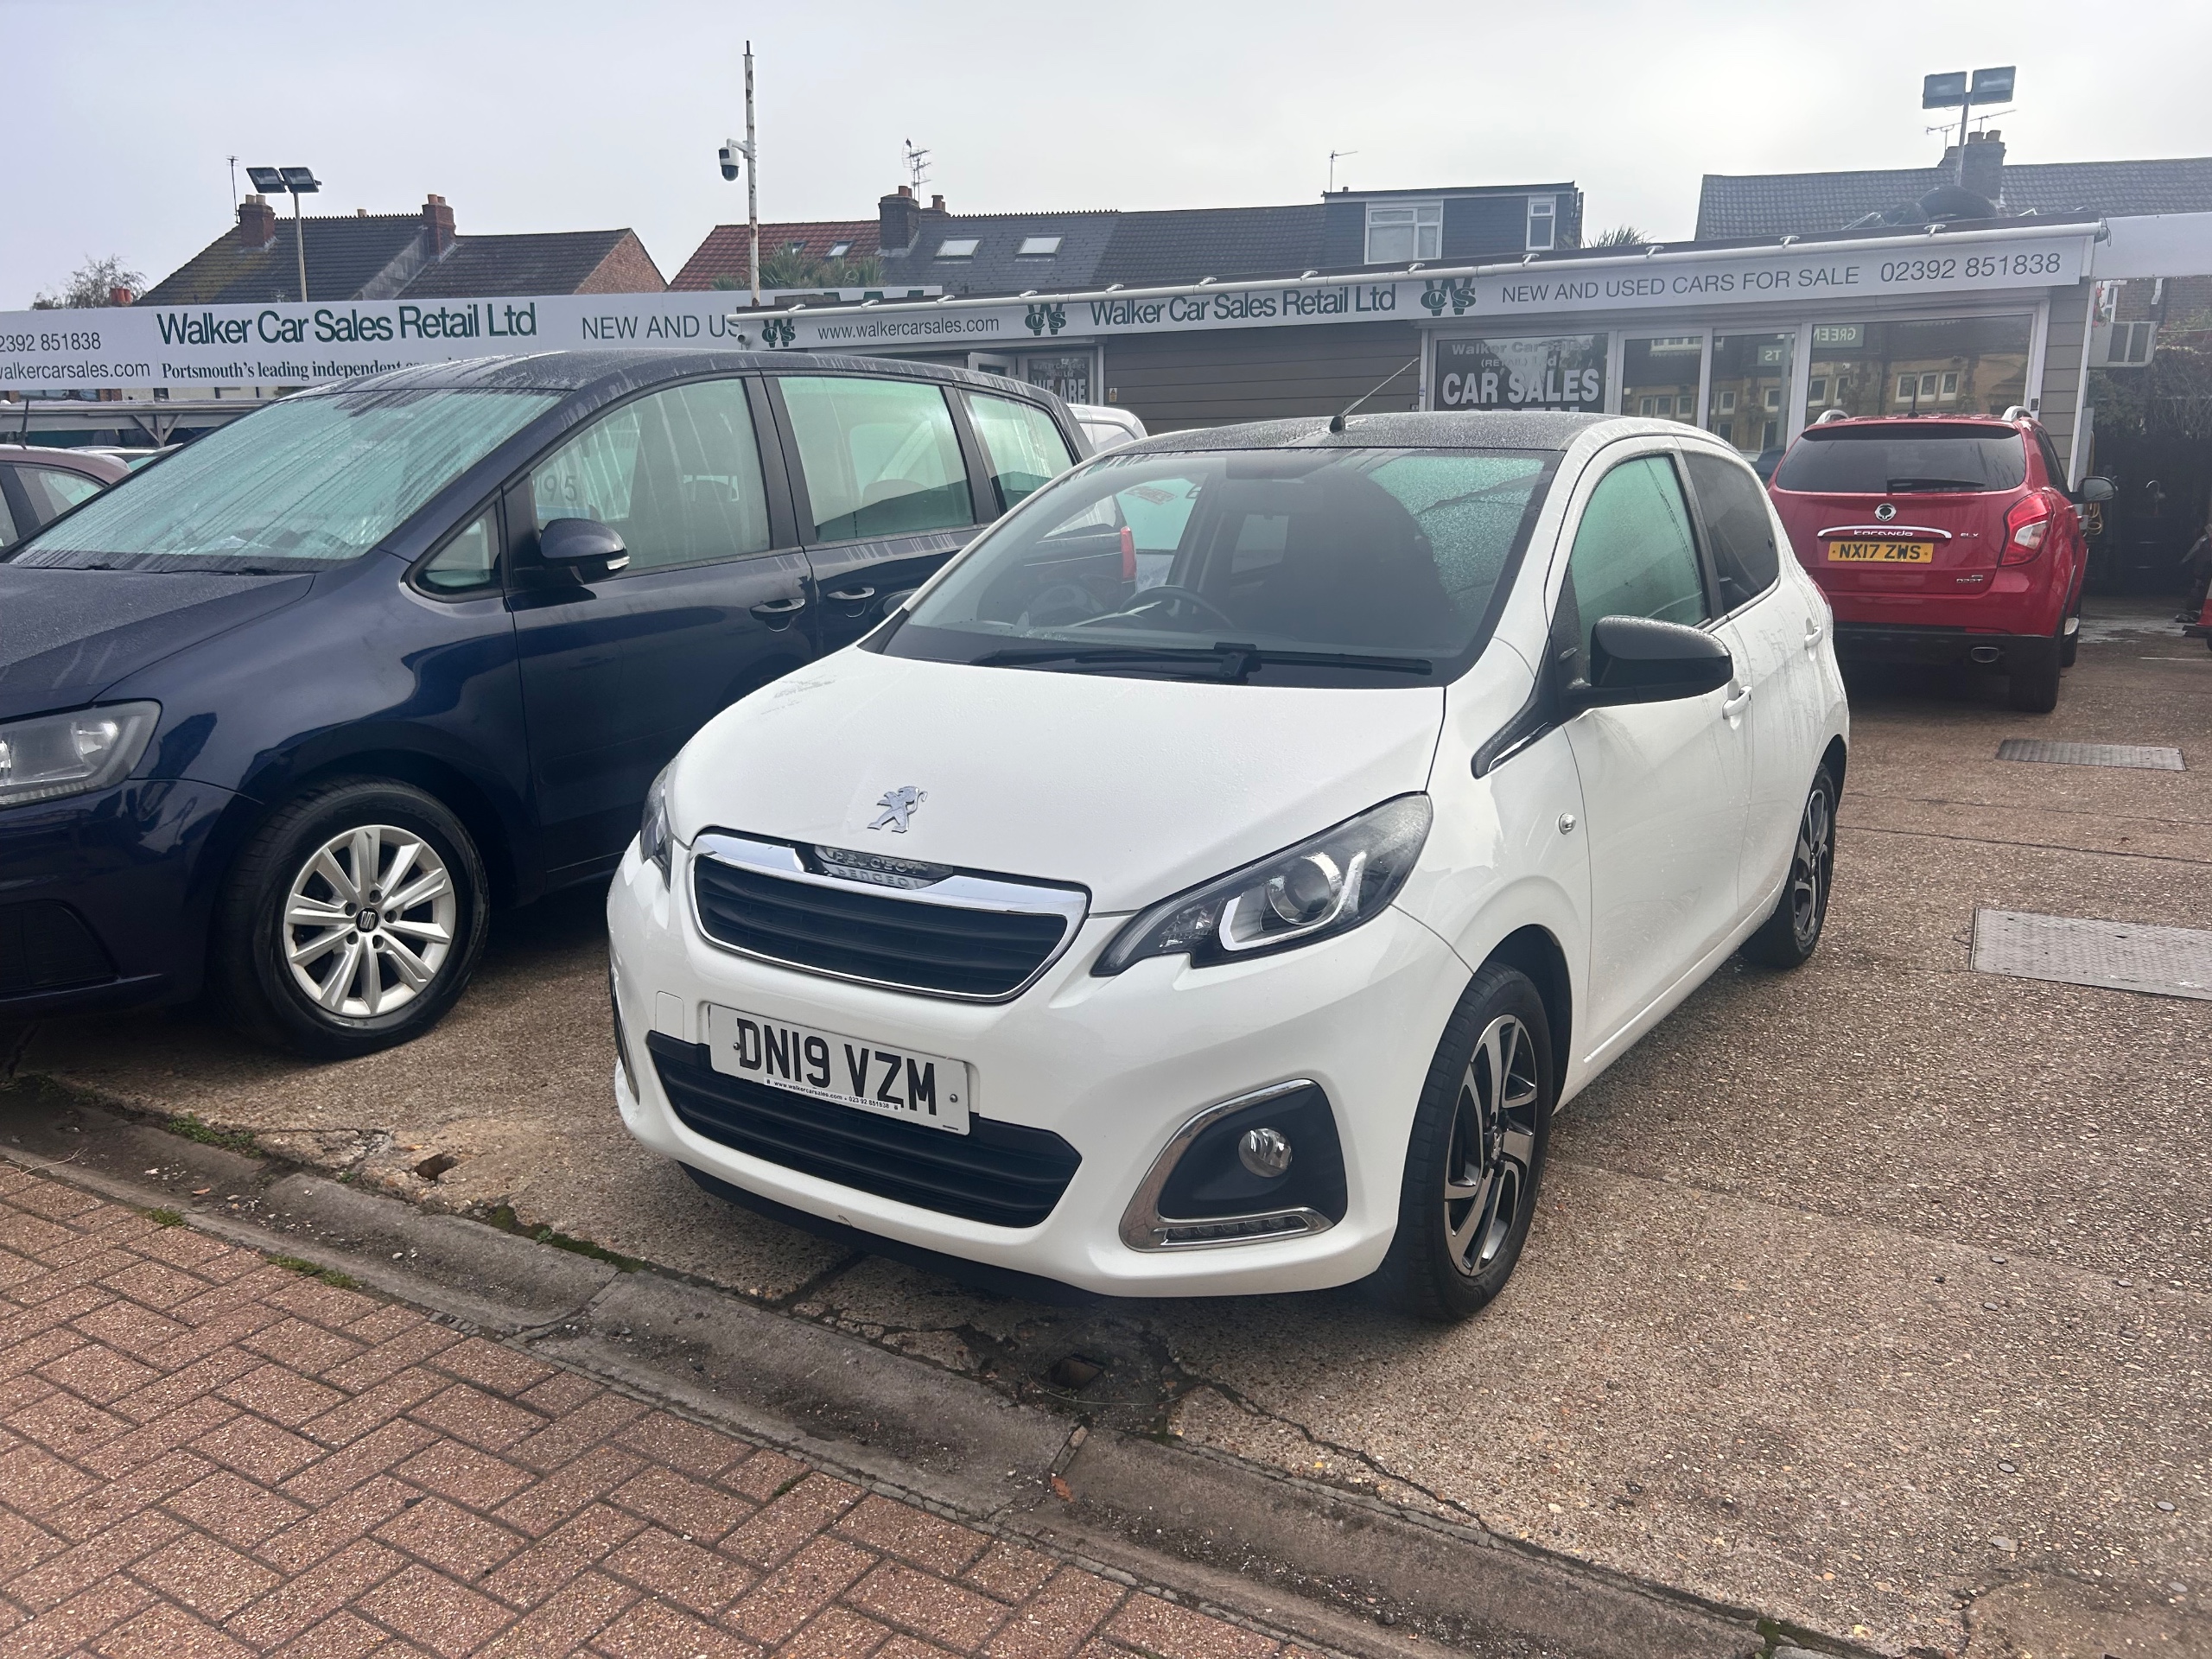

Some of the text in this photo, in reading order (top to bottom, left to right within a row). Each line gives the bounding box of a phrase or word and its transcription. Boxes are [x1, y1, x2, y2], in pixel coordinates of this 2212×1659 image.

[1502, 253, 2062, 302] NEW AND USED CARS FOR SALE 02392 851838
[1090, 283, 1396, 326] Walker Car Sales Retail Ltd
[156, 302, 537, 345] Walker Car Sales Retail Ltd
[582, 316, 638, 340] NEW
[646, 315, 700, 339] AND
[817, 316, 1000, 340] www.walkercarsales.com
[41, 332, 101, 351] 851838
[1452, 342, 1506, 355] Walker
[1511, 341, 1539, 353] Car
[0, 360, 150, 379] alkercarsales.com
[162, 361, 255, 378] Portsmouth's
[257, 361, 309, 380] leading
[1059, 378, 1086, 404] ARE
[1442, 368, 1599, 405] CAR SALES
[1839, 543, 1921, 560] NX17 ZWS
[736, 1017, 938, 1116] DN19 VZM
